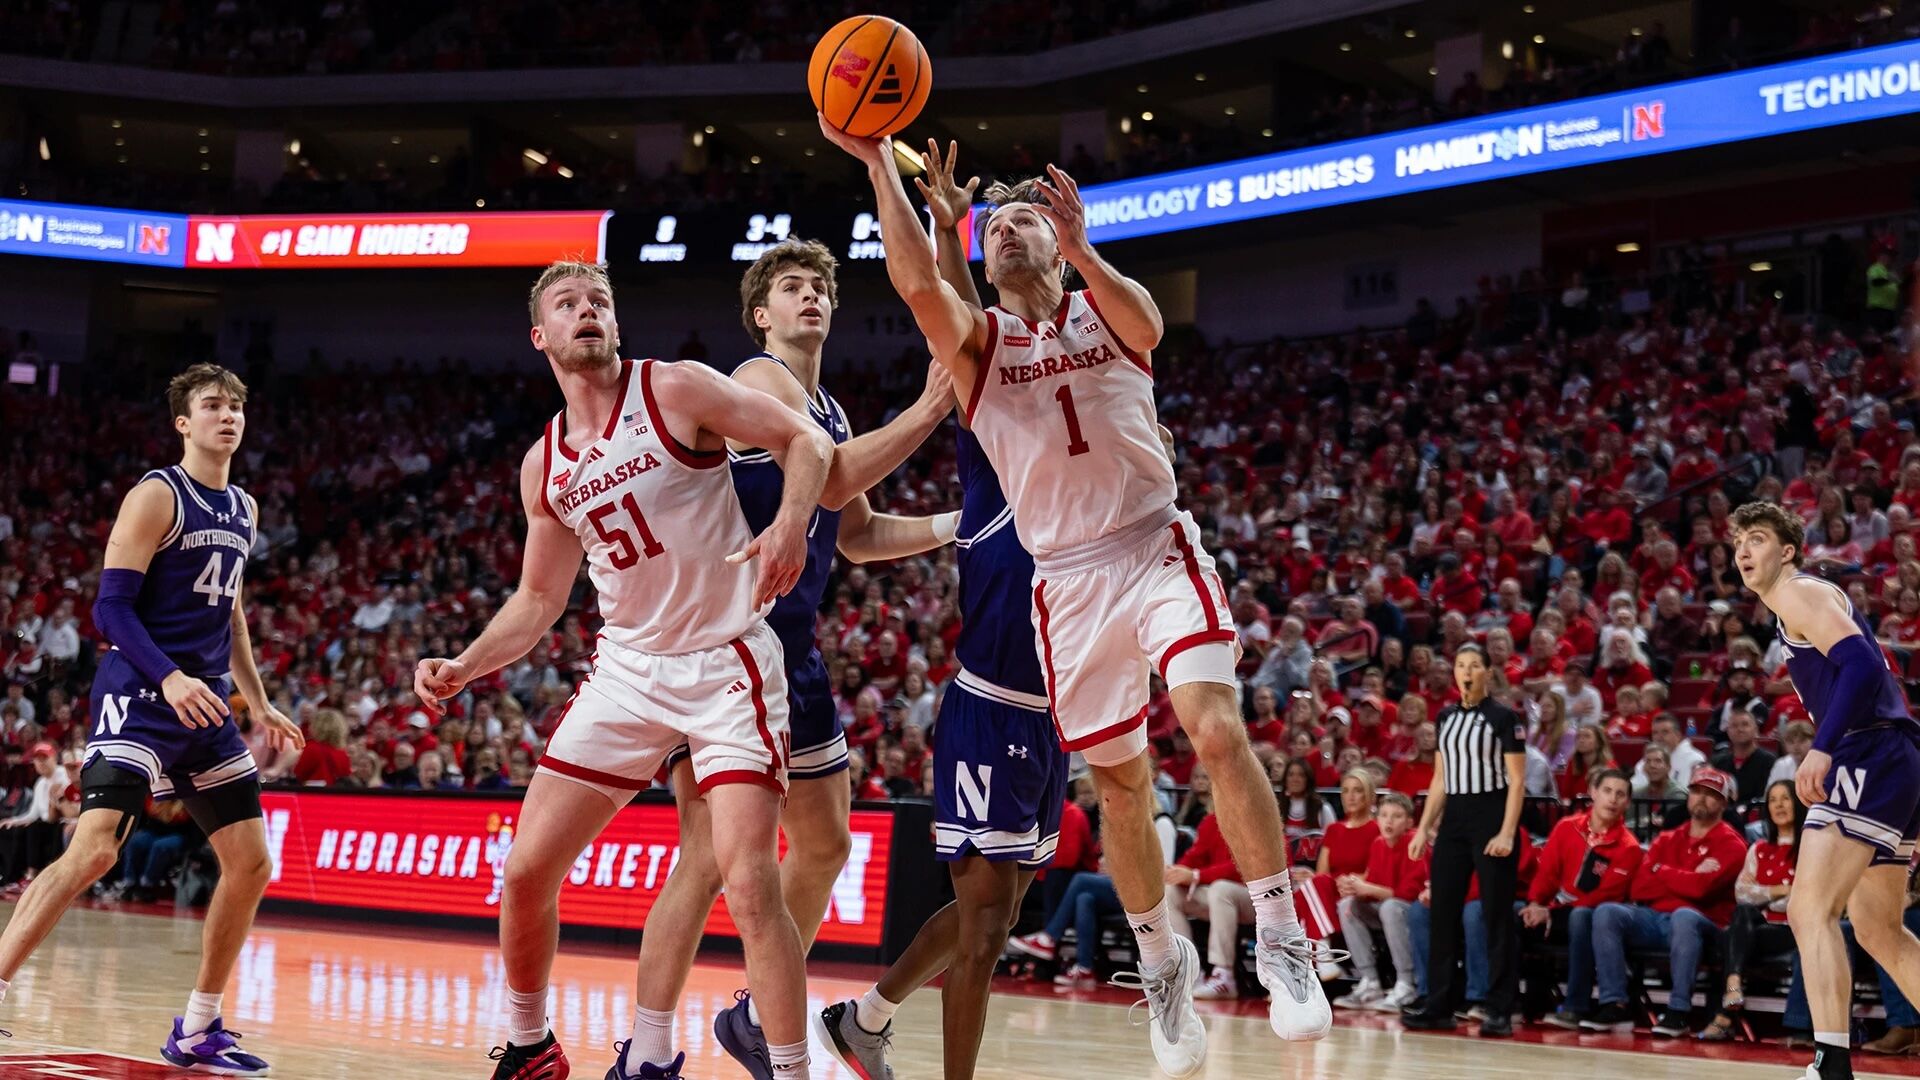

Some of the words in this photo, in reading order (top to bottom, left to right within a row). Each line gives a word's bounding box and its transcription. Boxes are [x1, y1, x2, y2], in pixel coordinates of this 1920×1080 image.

[1545, 117, 1599, 138] Business
[1546, 128, 1621, 152] Technologies
[1632, 101, 1666, 141] N
[1207, 178, 1234, 208] IS
[1238, 154, 1375, 203] BUSINESS
[47, 215, 103, 234] Business
[47, 230, 125, 250] Technologies
[138, 222, 171, 255] N
[197, 222, 235, 263] N
[261, 229, 291, 257] #1
[295, 224, 354, 257] SAM
[357, 223, 468, 257] HOIBERG
[746, 214, 791, 241] 3-4
[999, 343, 1117, 386] NEBRASKA
[1055, 384, 1090, 456] 1
[557, 452, 662, 515] NEBRASKA
[586, 491, 665, 571] 51
[193, 551, 244, 611] 44
[95, 693, 131, 736] N
[955, 760, 992, 821] N
[1829, 765, 1867, 810] N
[316, 829, 482, 879] NEBRASKA
